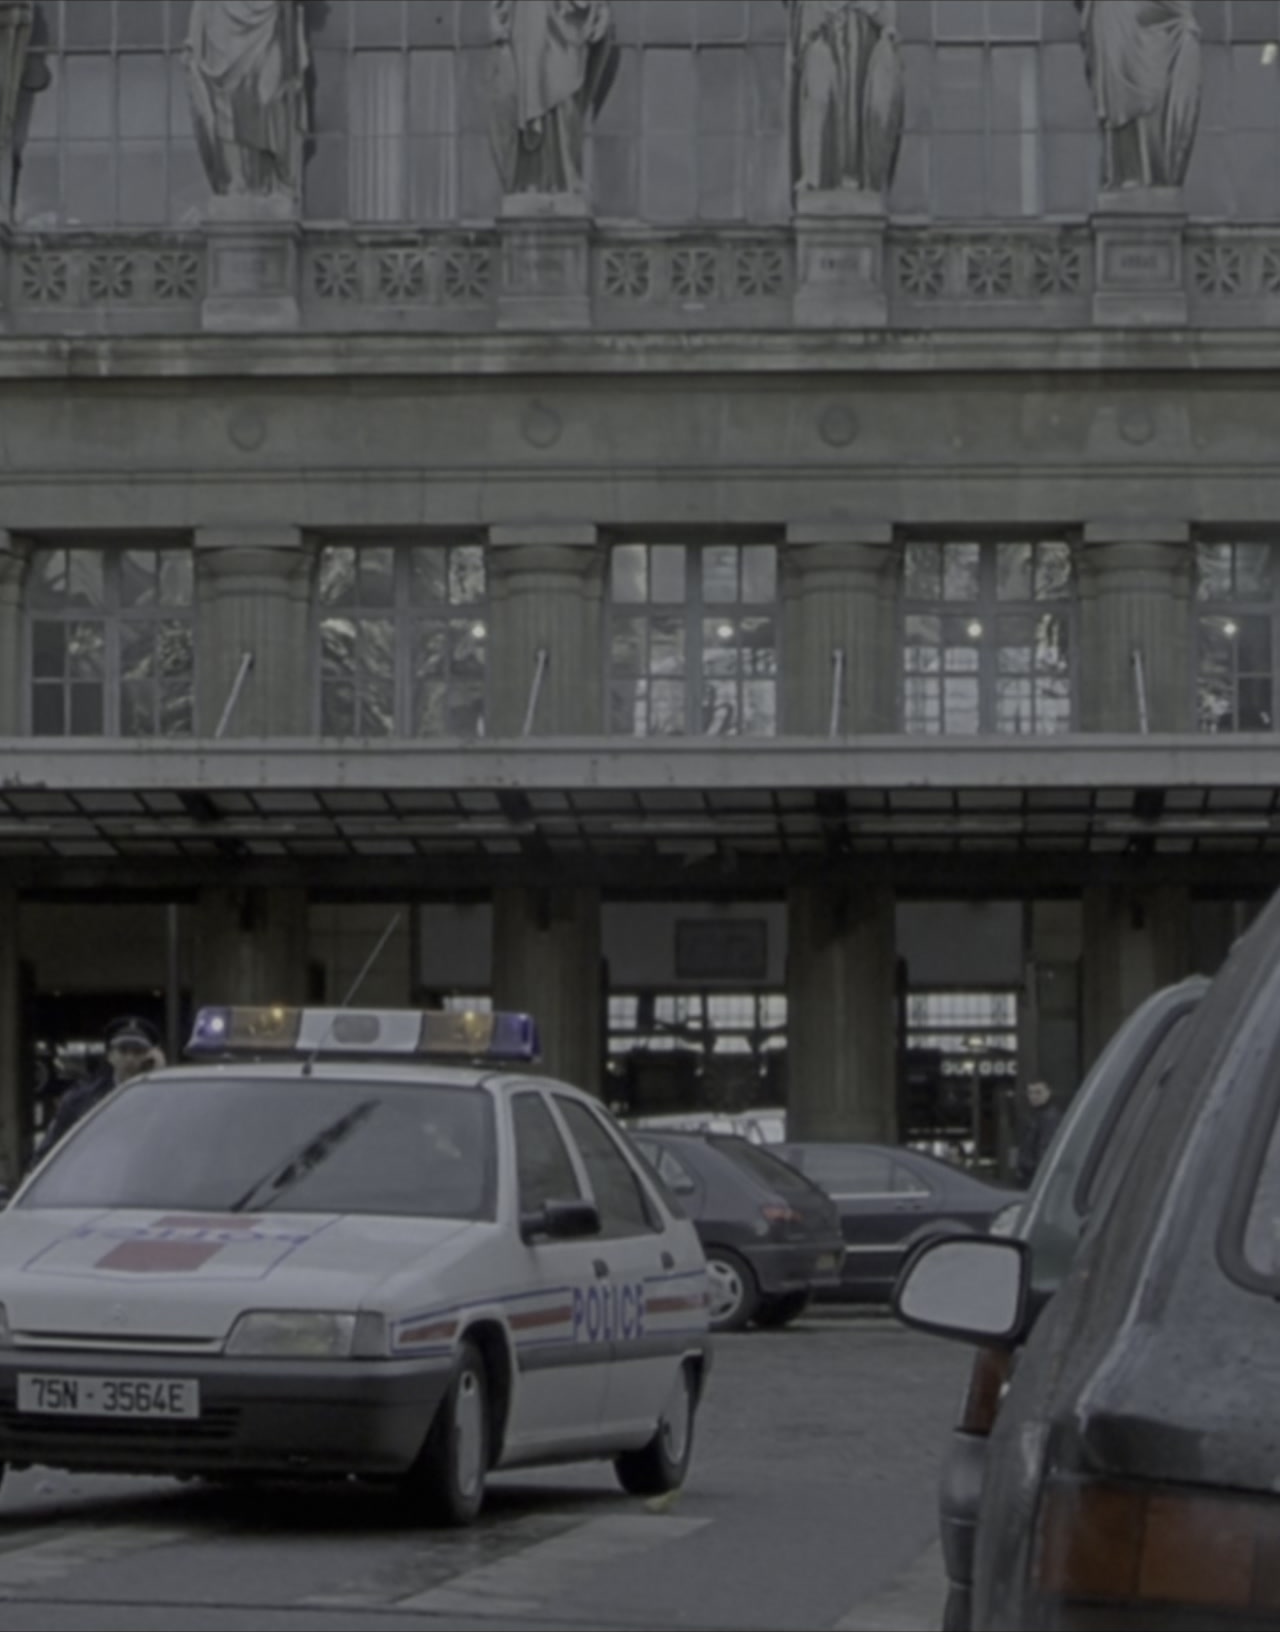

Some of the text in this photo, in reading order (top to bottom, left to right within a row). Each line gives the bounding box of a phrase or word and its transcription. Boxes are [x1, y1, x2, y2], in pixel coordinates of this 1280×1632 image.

[572, 1284, 644, 1341] POLICE
[31, 1378, 79, 1409] 75N
[102, 1381, 184, 1413] 3564E
